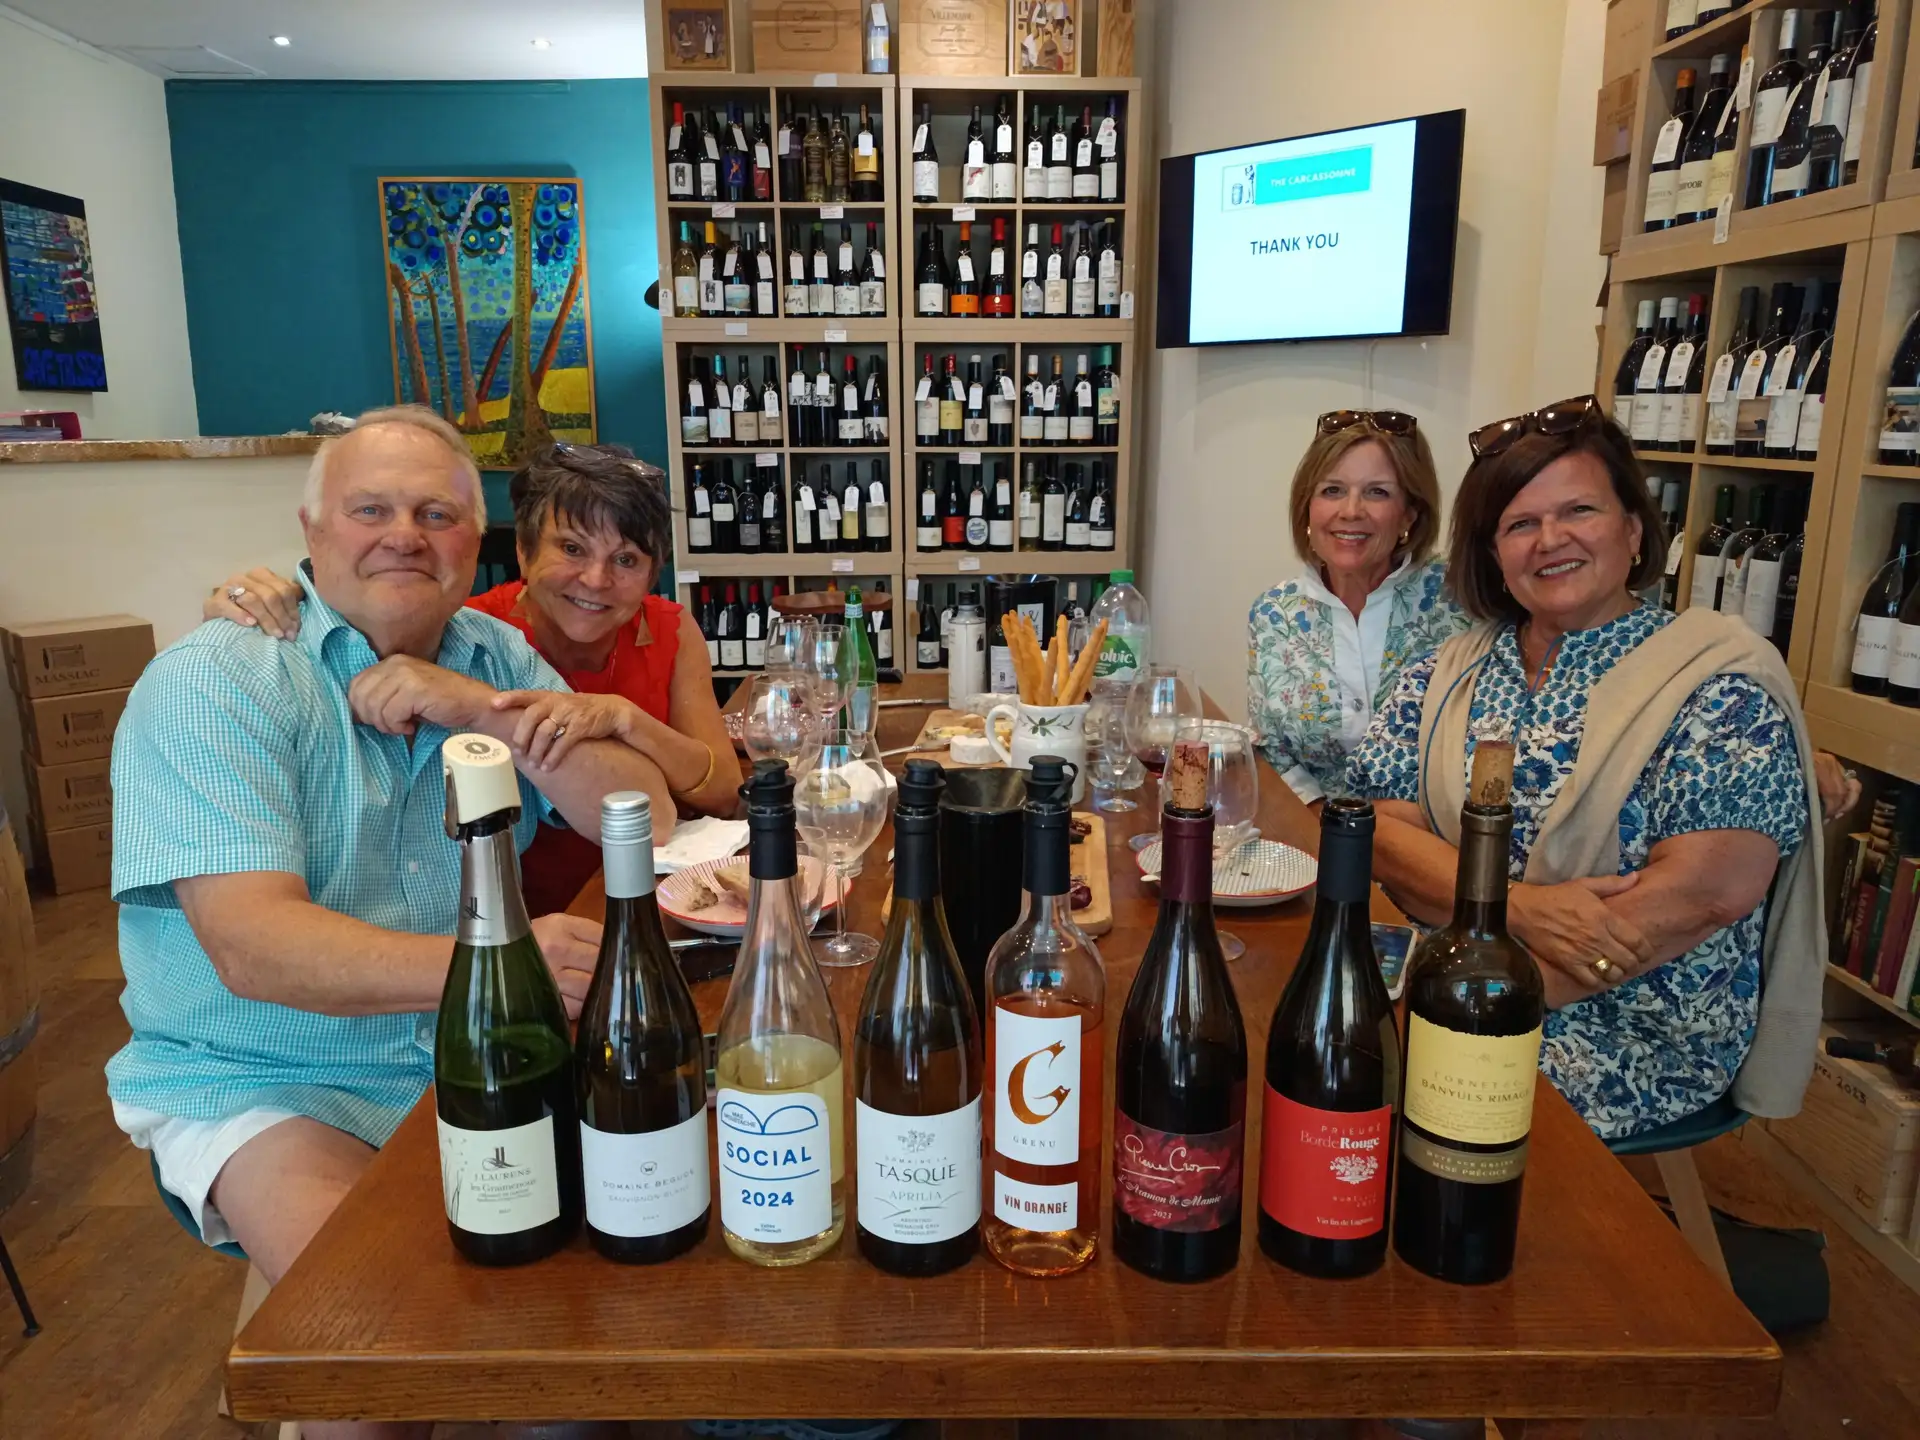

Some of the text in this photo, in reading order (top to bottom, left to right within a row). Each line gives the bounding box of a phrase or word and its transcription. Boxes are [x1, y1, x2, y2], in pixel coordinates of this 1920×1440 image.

[1271, 168, 1356, 188] THE CARCASSONNE
[1250, 232, 1339, 256] THANK YOU
[1100, 648, 1134, 665] olvic
[1421, 1078, 1529, 1104] BANYULS RIMAGE
[1012, 1134, 1057, 1149] GRENU
[726, 1141, 812, 1167] SOCIAL
[875, 1161, 959, 1187] TASQUE
[602, 1180, 650, 1190] DOMAINE
[741, 1188, 795, 1208] 2024
[1004, 1194, 1068, 1215] VIN ORANGE
[1168, 1194, 1179, 1206] de
